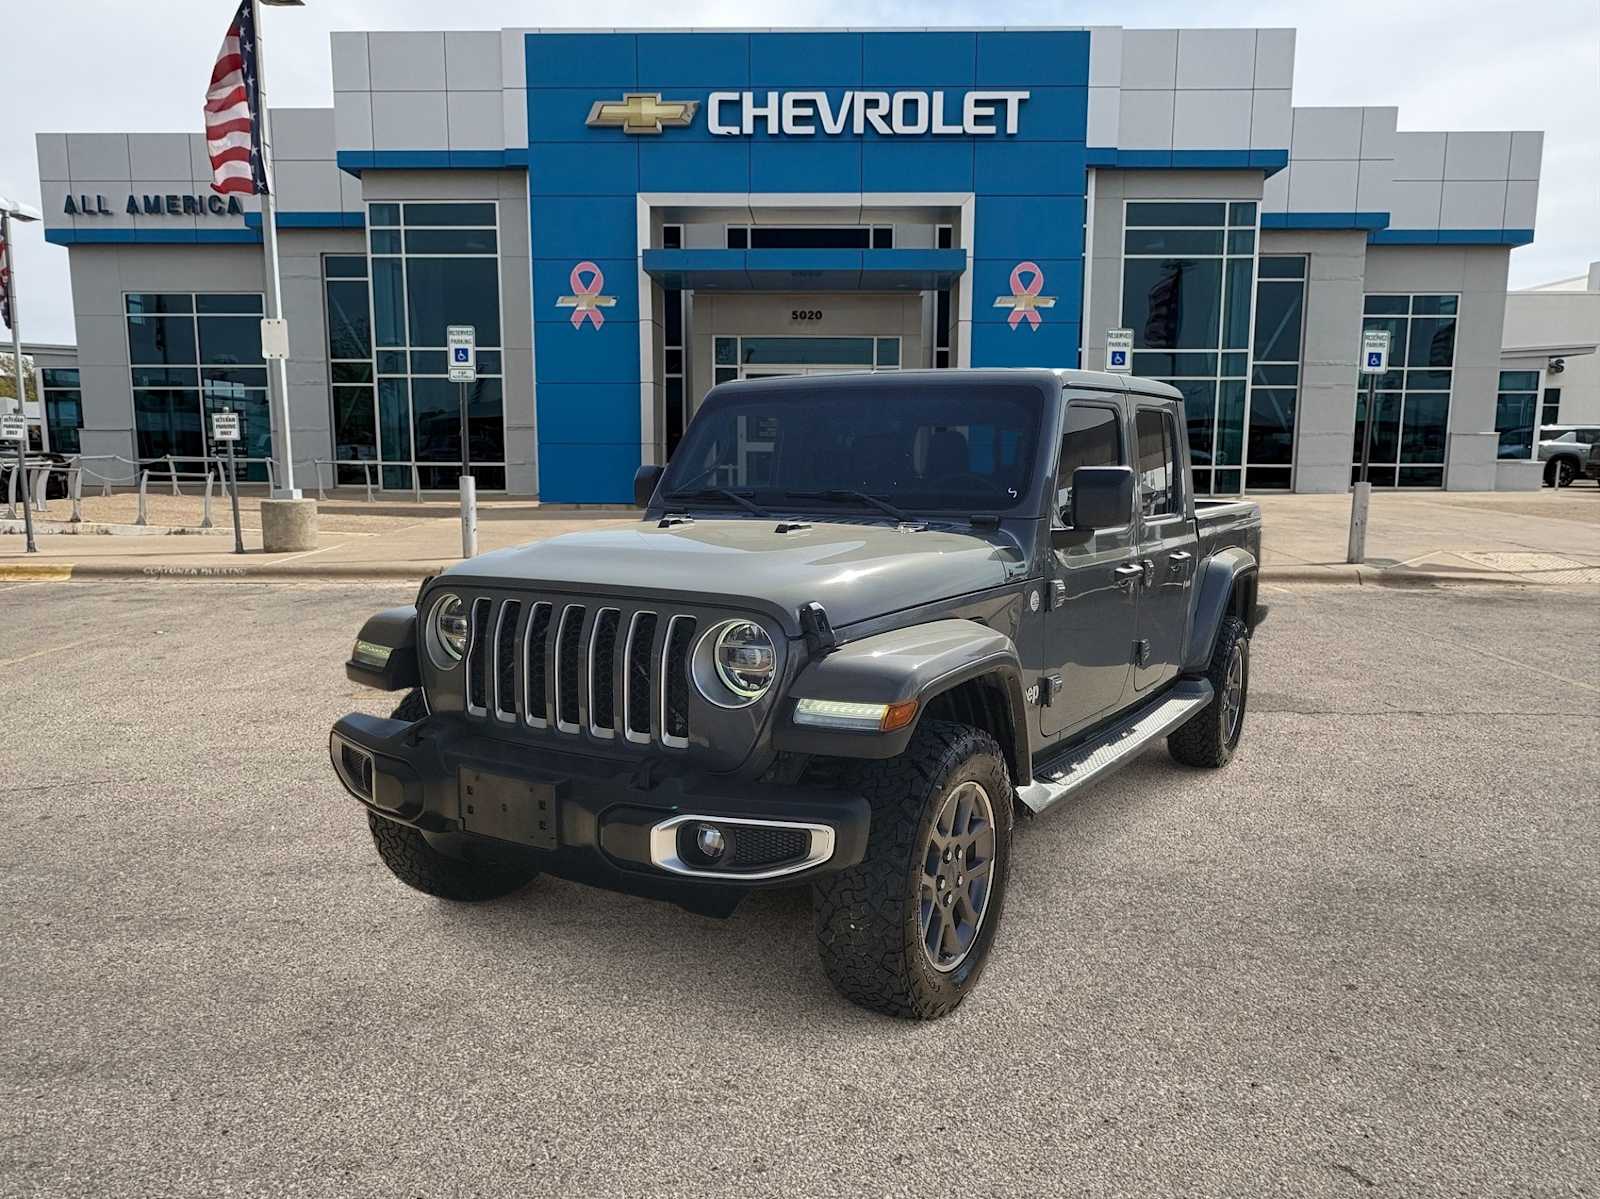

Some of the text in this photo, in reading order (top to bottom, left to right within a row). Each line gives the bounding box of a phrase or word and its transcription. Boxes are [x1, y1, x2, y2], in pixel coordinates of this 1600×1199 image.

[708, 91, 1030, 135] CHEVROLET
[64, 195, 109, 214] ALL
[791, 310, 823, 320] 5020
